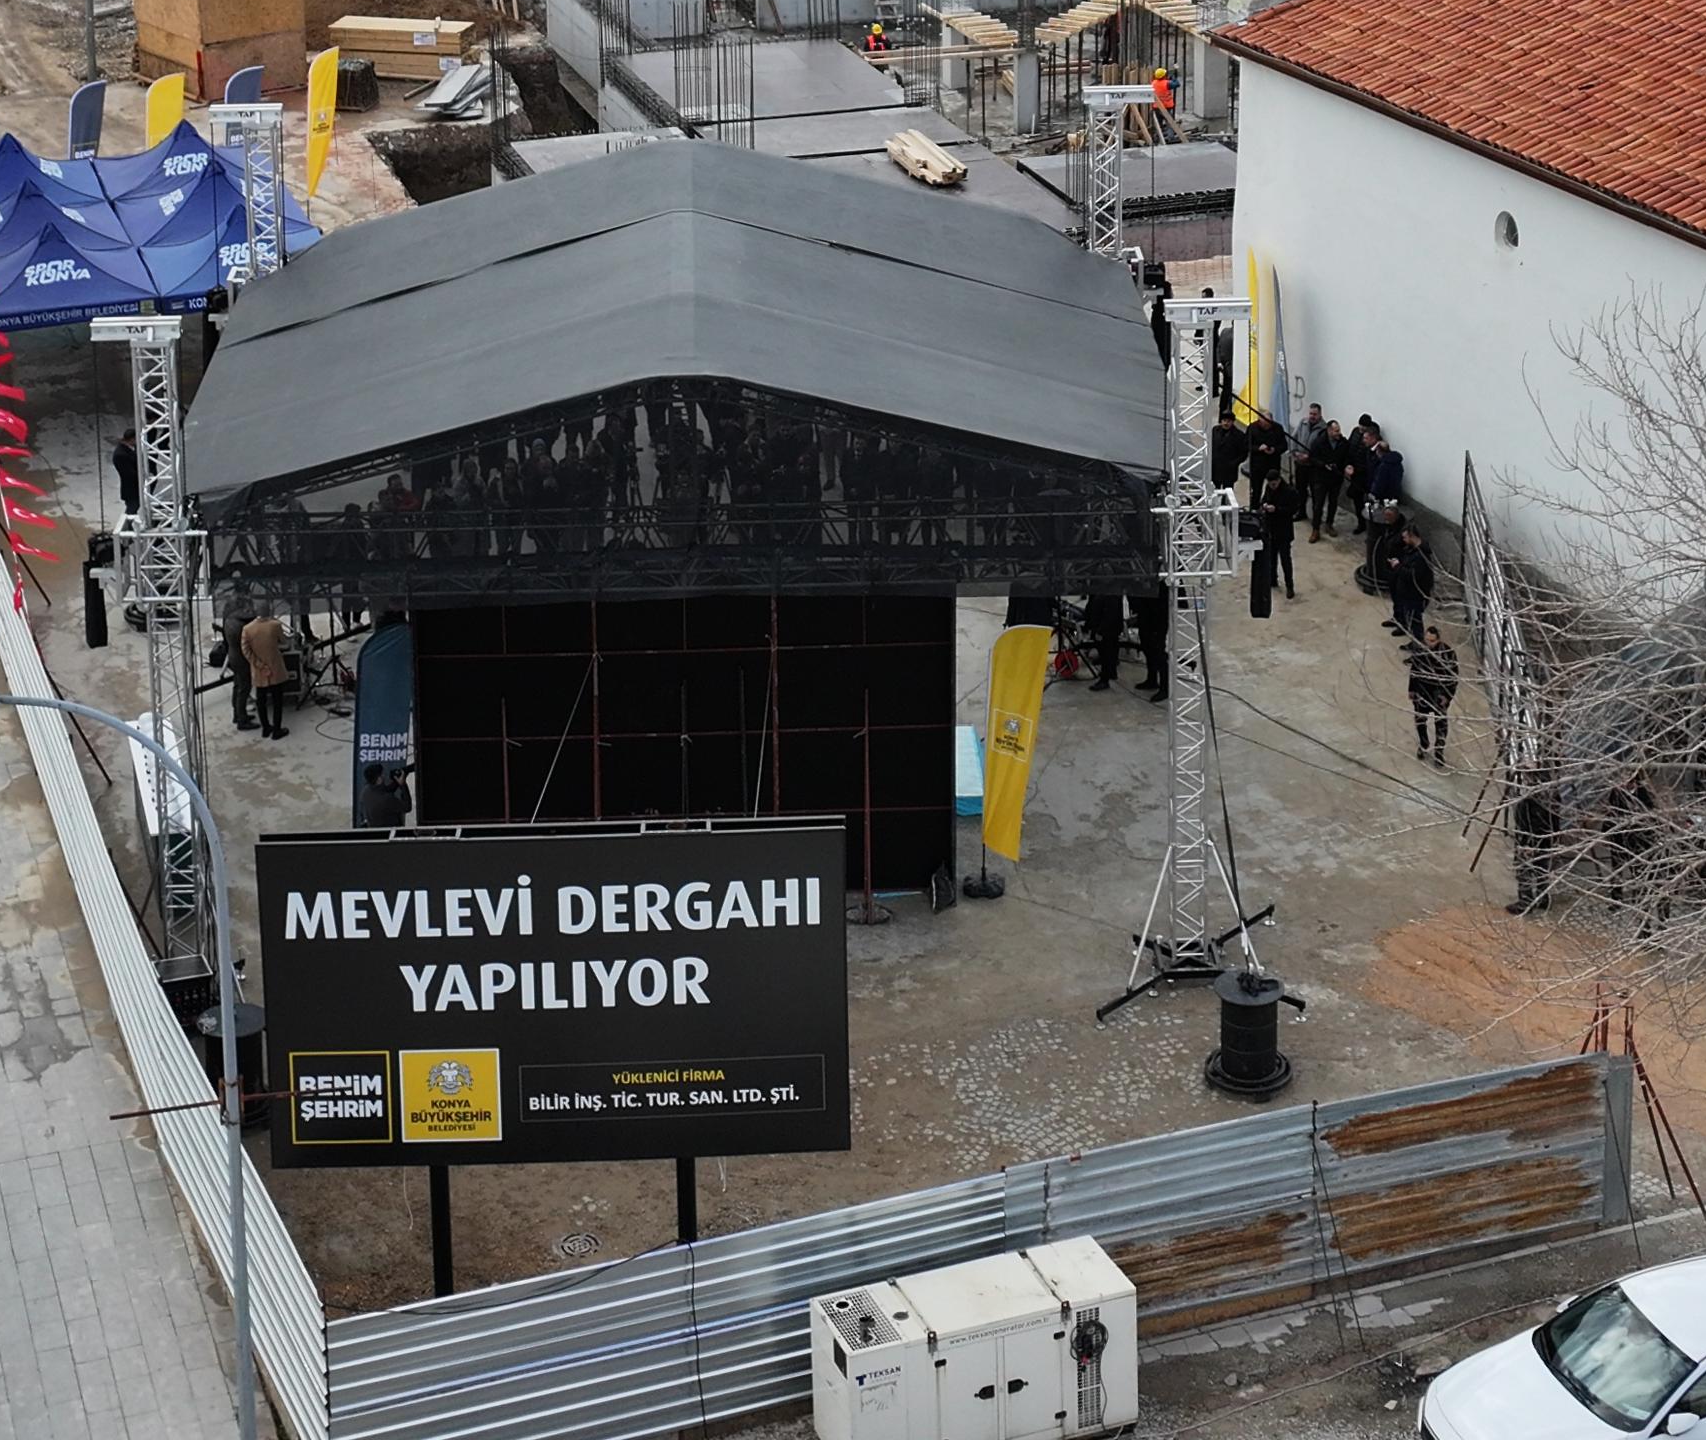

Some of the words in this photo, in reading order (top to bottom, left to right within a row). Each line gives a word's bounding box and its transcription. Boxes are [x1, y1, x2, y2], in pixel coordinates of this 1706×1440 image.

[24, 259, 75, 279] SPOR
[26, 267, 91, 287] KONYA
[23, 307, 84, 326] BÜYÜKŞEHİR
[284, 874, 534, 940] MEVLEVİ
[557, 877, 821, 935] DERGAHI
[399, 956, 711, 1012] YAPILIYOR
[612, 1069, 680, 1085] YÜKLENİCİ
[682, 1068, 726, 1083] FİRMA
[430, 1098, 472, 1110] KONYA
[529, 1092, 571, 1111] BİLİR
[574, 1091, 607, 1112] İNŞ.
[611, 1090, 643, 1108] TİC.
[646, 1092, 685, 1107] TUR.
[689, 1090, 729, 1105] SAN.
[732, 1088, 767, 1103] LTD.
[770, 1083, 800, 1105] ŞTİ.
[410, 1107, 493, 1124] BÜYÜKŞEHİR
[427, 1123, 477, 1133] BELEDİYESİ
[868, 1365, 901, 1380] TEKSAN
